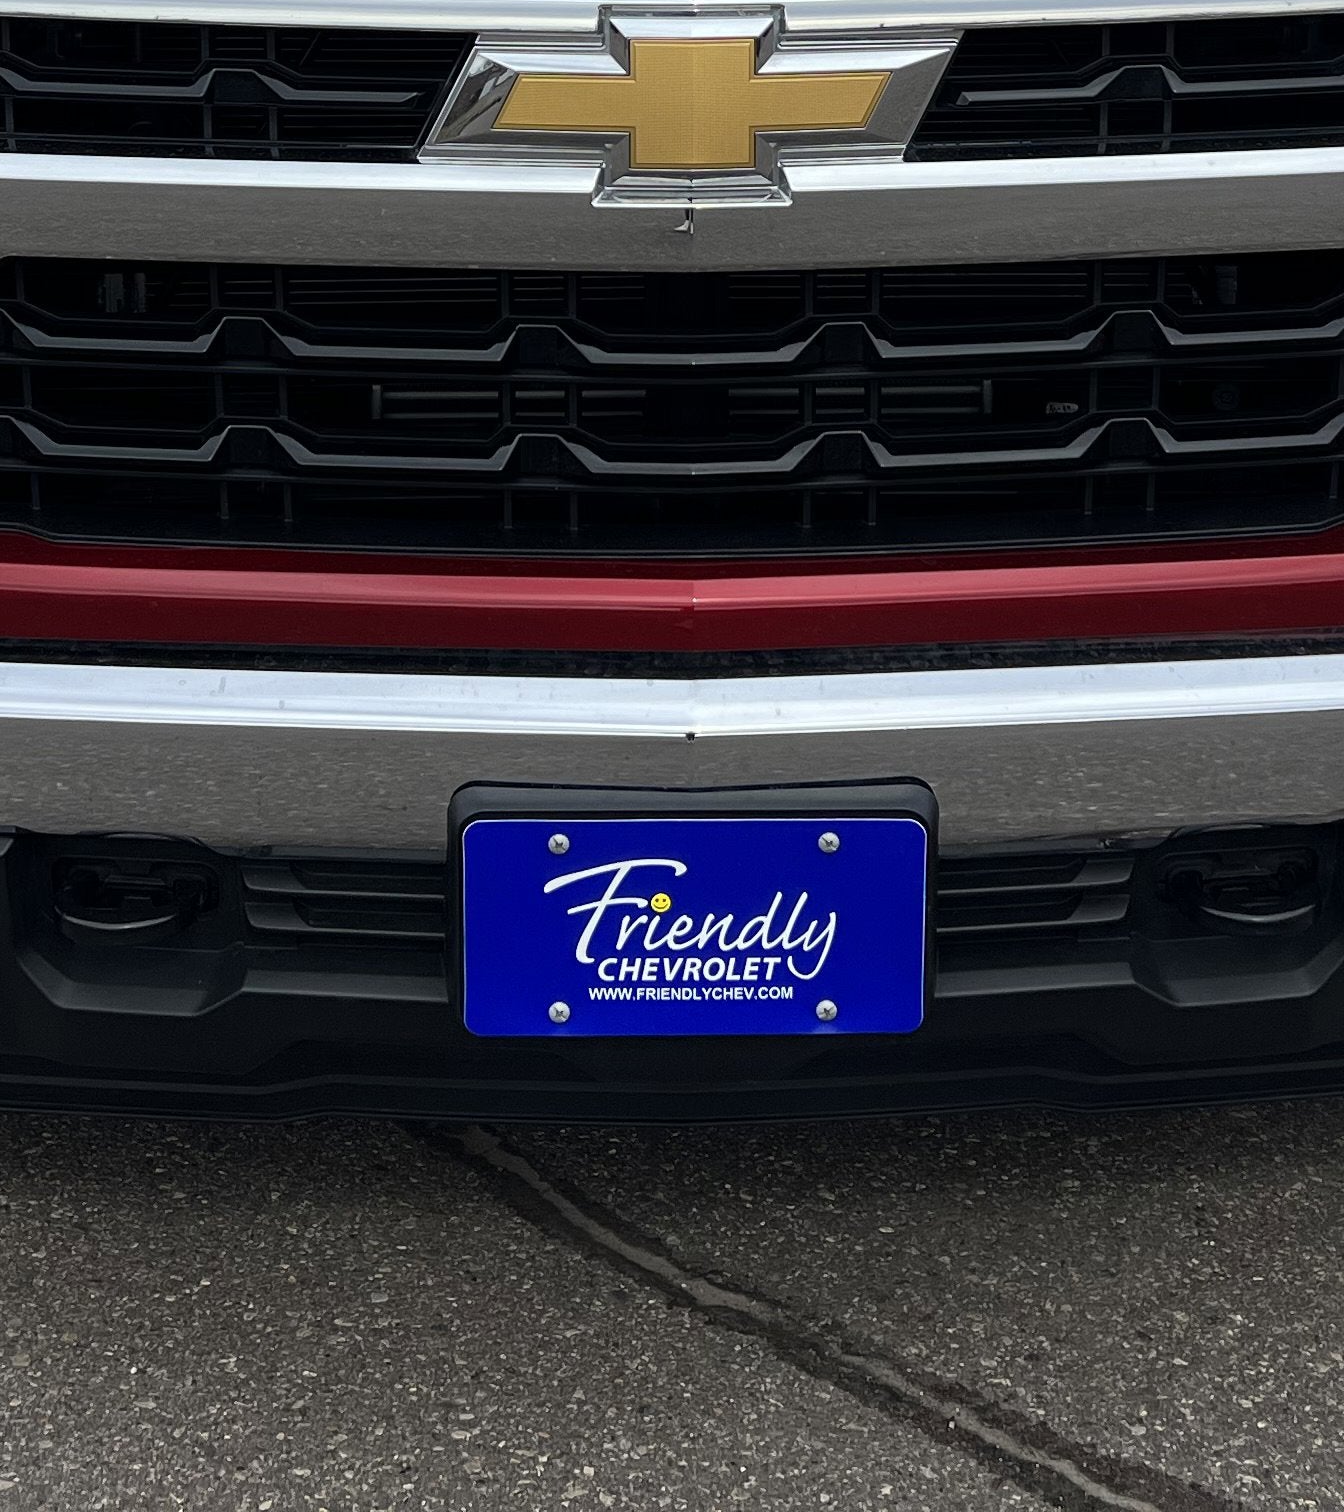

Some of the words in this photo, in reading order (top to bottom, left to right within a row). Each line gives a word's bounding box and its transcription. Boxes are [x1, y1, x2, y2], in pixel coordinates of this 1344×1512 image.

[543, 858, 837, 980] Friendly
[597, 957, 782, 981] CHEVROLET
[588, 986, 793, 1001] WWW.FRIENDLYCHEV.COM
